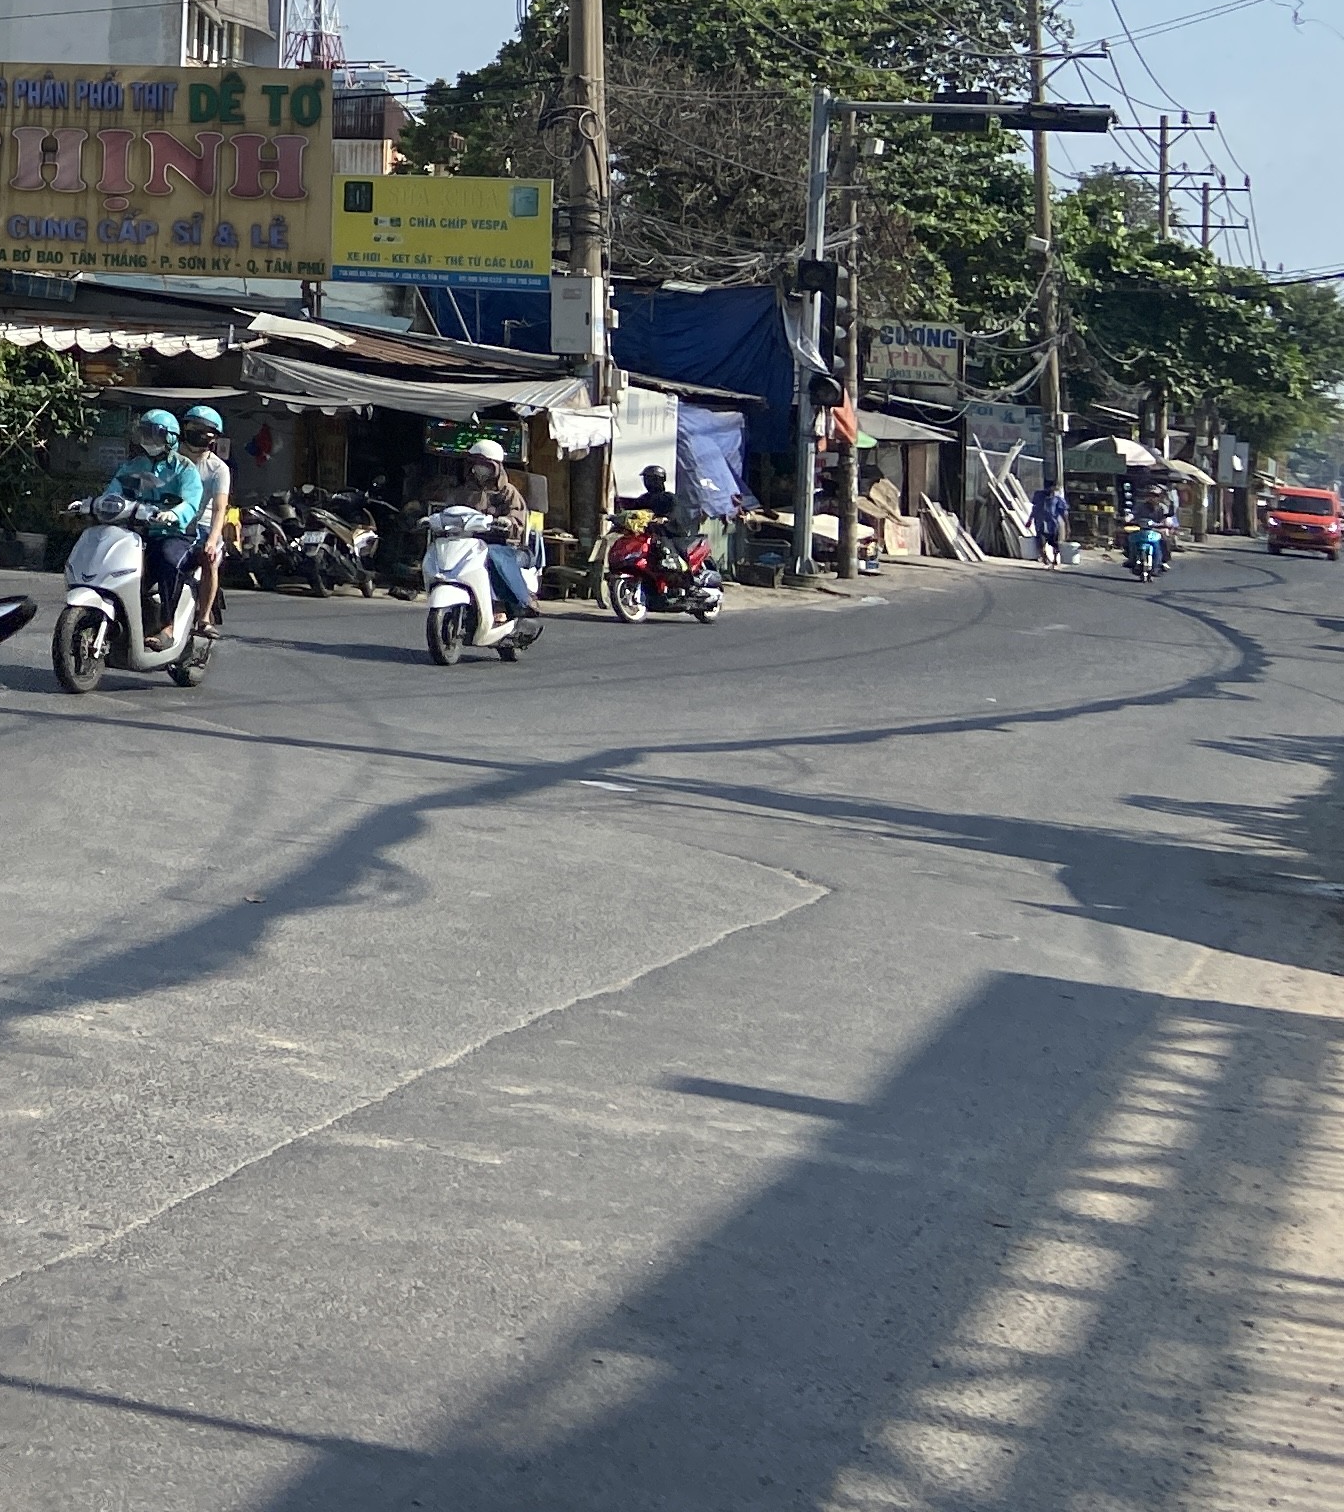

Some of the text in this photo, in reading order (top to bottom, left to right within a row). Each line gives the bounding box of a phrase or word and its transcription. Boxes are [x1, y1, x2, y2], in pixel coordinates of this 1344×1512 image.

[13, 70, 69, 110] PHÂN
[74, 70, 123, 111] PHỐI
[132, 82, 179, 121] THỊT
[189, 72, 245, 124] DÊ
[262, 79, 324, 127] TƠ
[7, 214, 89, 243] CUNG
[97, 209, 159, 246] CẤP
[213, 220, 238, 249] &
[409, 214, 508, 231] CHÌA CHÍP VESPA
[13, 245, 31, 263] BỜ
[36, 250, 64, 264] BAO
[70, 250, 97, 265] TÂN
[102, 250, 148, 268] THẮNG
[160, 256, 172, 269] P.
[178, 255, 206, 270] SƠN
[211, 254, 232, 271] KỲ
[246, 260, 259, 275] Q.
[265, 259, 292, 274] TÂN
[297, 258, 325, 275] PHÚ
[346, 251, 361, 263] XE
[484, 256, 507, 269] CÁC
